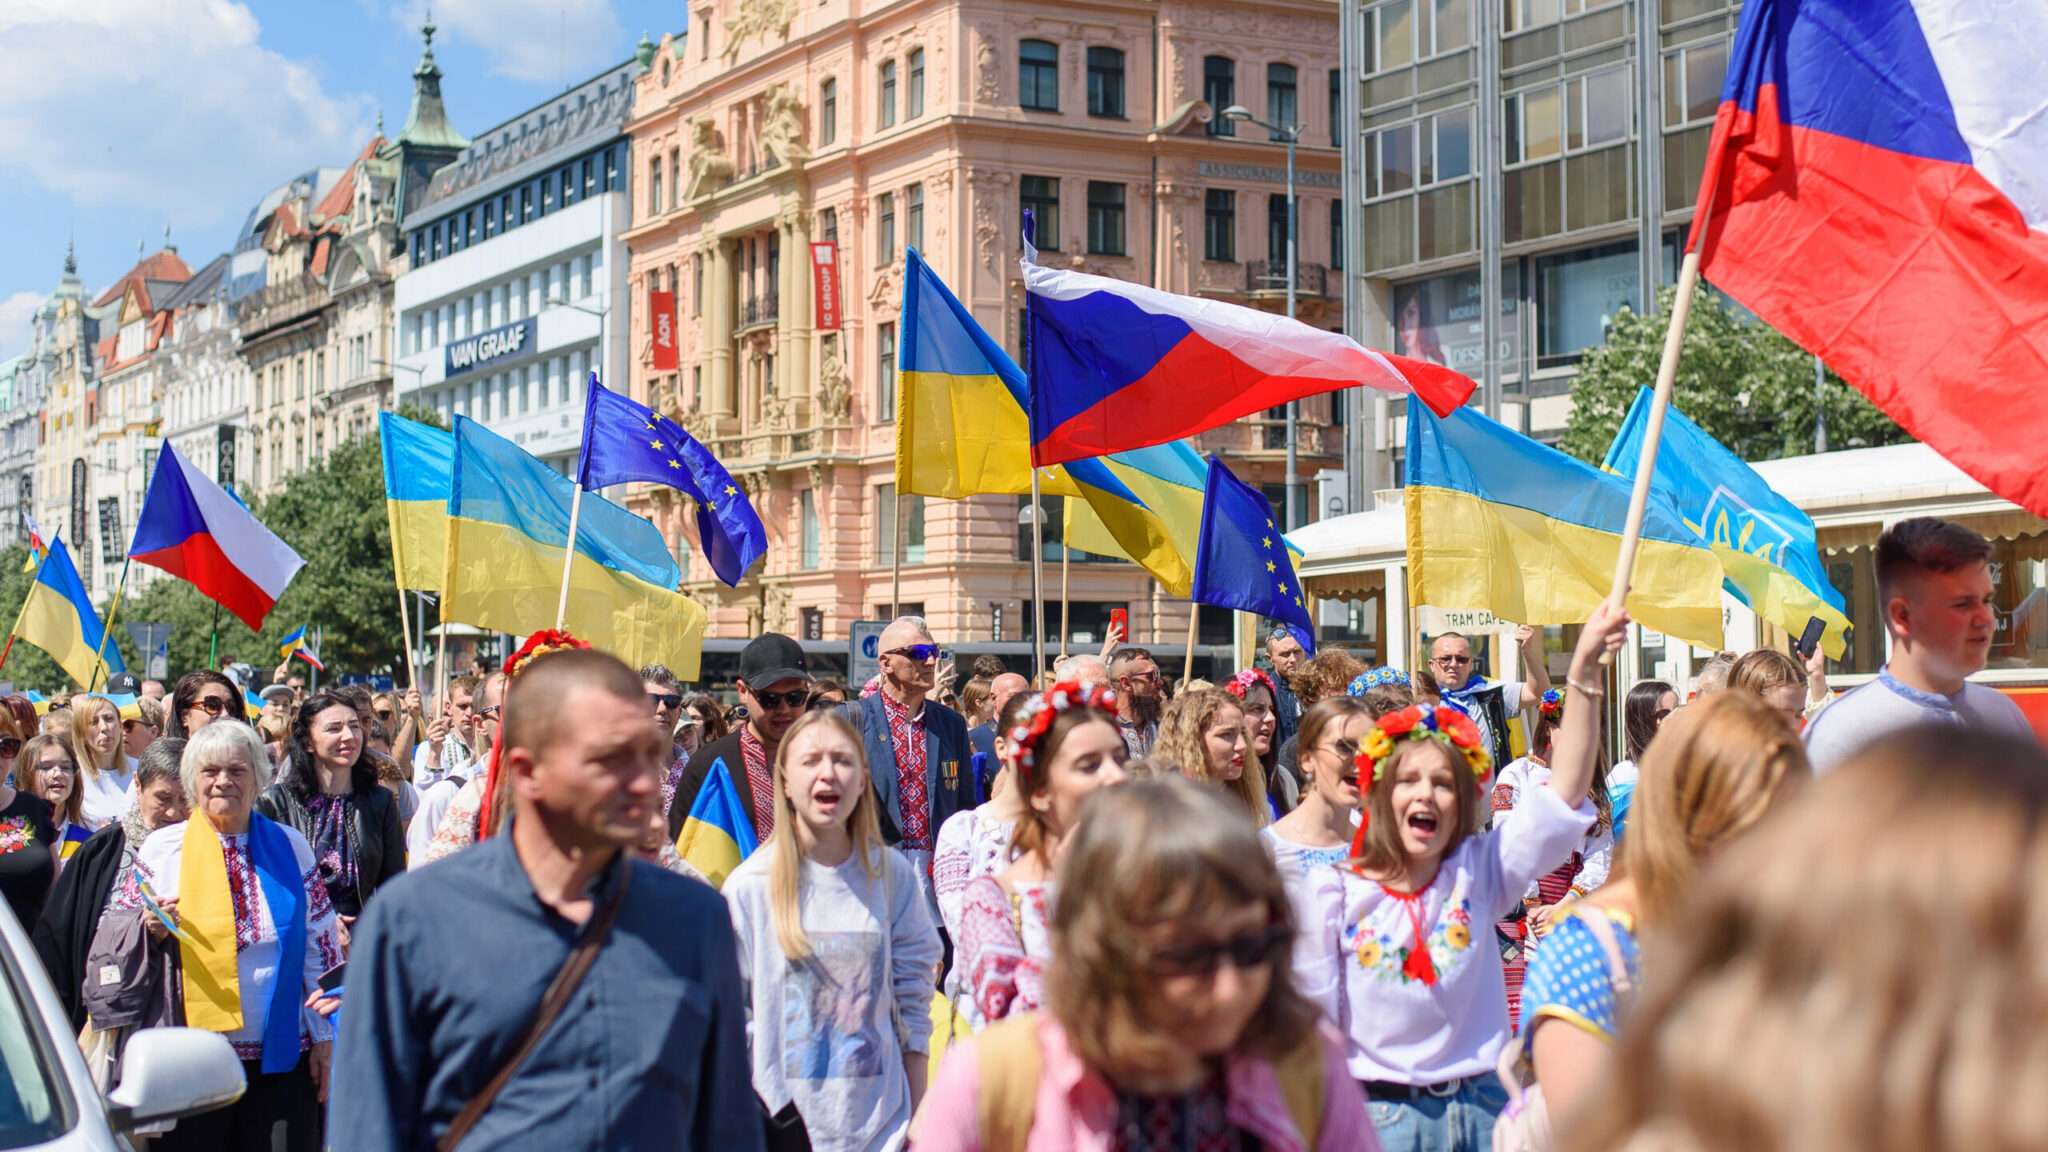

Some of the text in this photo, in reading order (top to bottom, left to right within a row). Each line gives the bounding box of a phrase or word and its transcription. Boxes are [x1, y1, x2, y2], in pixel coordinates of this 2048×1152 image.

[822, 267, 832, 311] GROUP
[451, 324, 525, 369] VAN GRAAF
[658, 313, 672, 349] AON
[1445, 613, 1474, 627] TRAM
